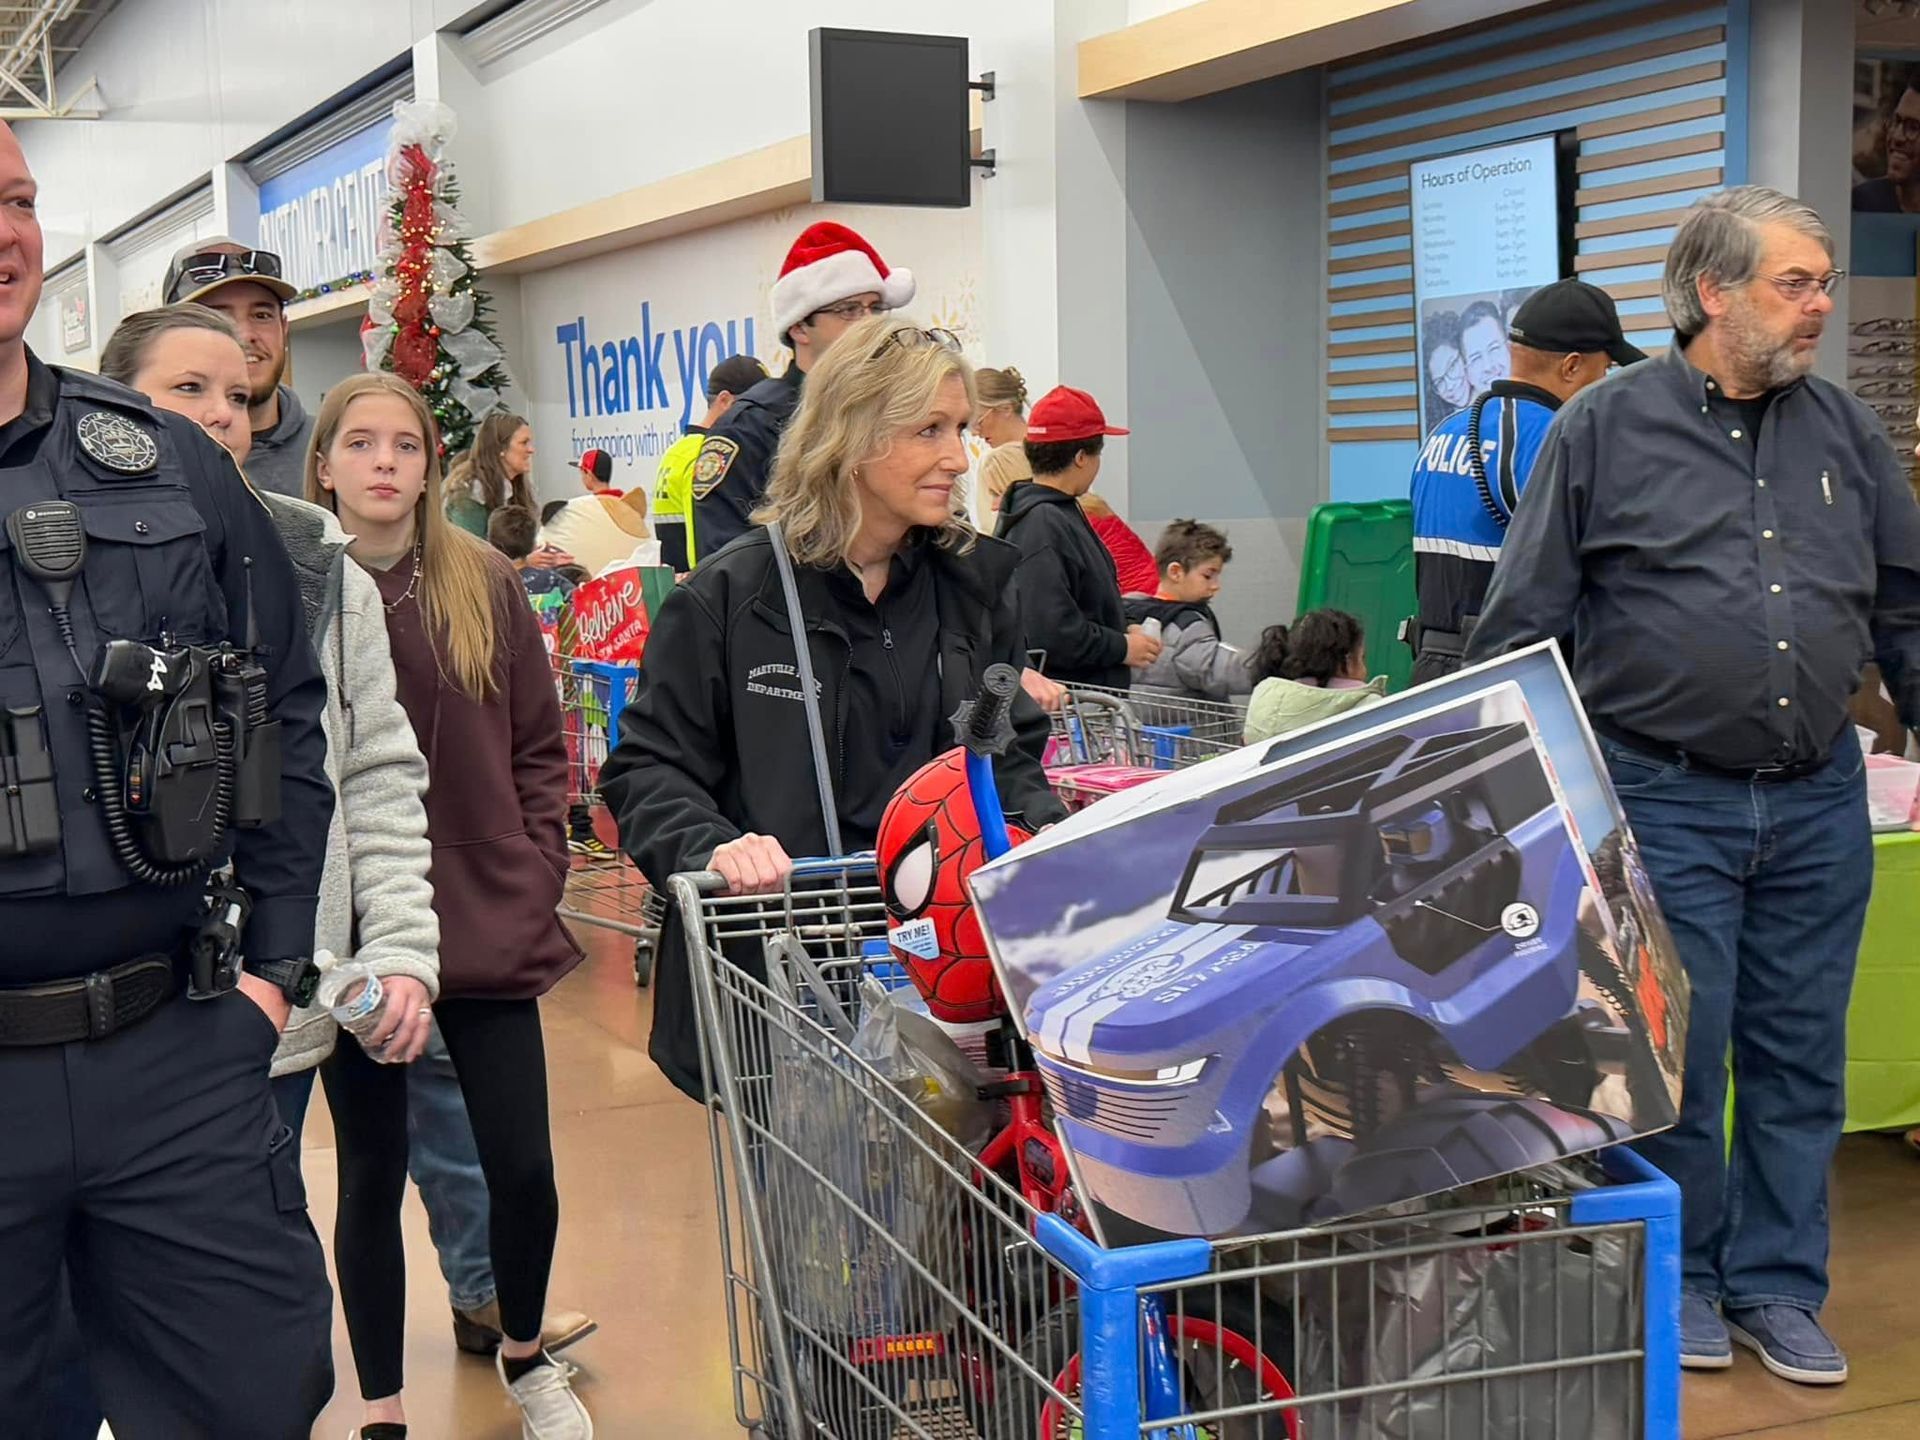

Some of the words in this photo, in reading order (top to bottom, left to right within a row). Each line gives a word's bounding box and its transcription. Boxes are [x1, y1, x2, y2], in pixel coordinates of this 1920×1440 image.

[1421, 172, 1455, 189] Hours
[1457, 164, 1470, 182] of
[1472, 157, 1532, 182] Operation
[556, 301, 669, 418] Thank
[572, 427, 586, 458] for
[587, 426, 633, 466] shopping
[635, 422, 659, 457] with
[1416, 433, 1497, 478] POLICE
[599, 586, 609, 602] I
[577, 581, 642, 645] Believe
[613, 619, 643, 651] SANTA
[746, 681, 806, 701] DEPARTME
[896, 929, 912, 943] TRY
[914, 924, 930, 938] ME!
